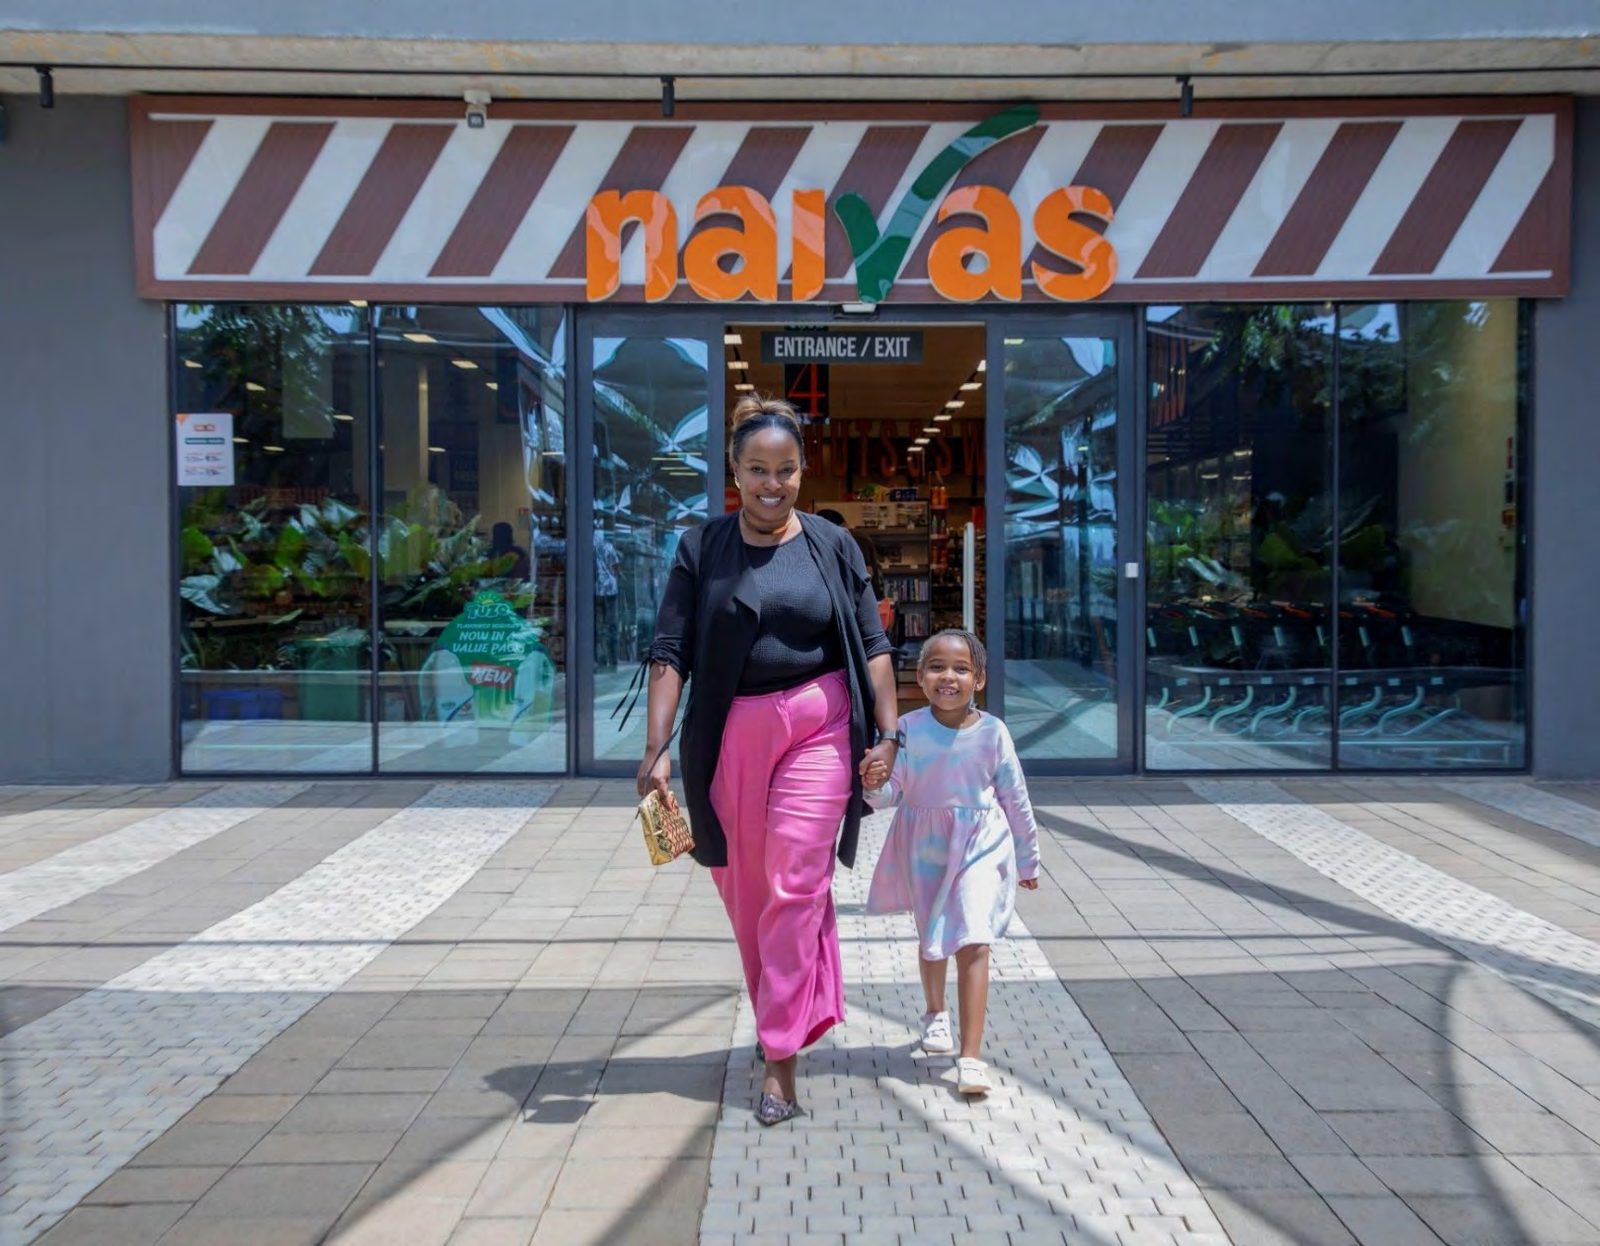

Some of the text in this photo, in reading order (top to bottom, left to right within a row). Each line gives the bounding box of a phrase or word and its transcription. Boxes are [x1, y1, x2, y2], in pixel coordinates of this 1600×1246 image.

[586, 104, 1118, 304] naivas
[774, 336, 911, 358] ENTRANCE / EXIT
[788, 362, 826, 416] 4
[460, 631, 489, 641] NOW
[491, 631, 505, 641] IN
[453, 643, 488, 652] VALUE
[472, 667, 511, 684] NEW
